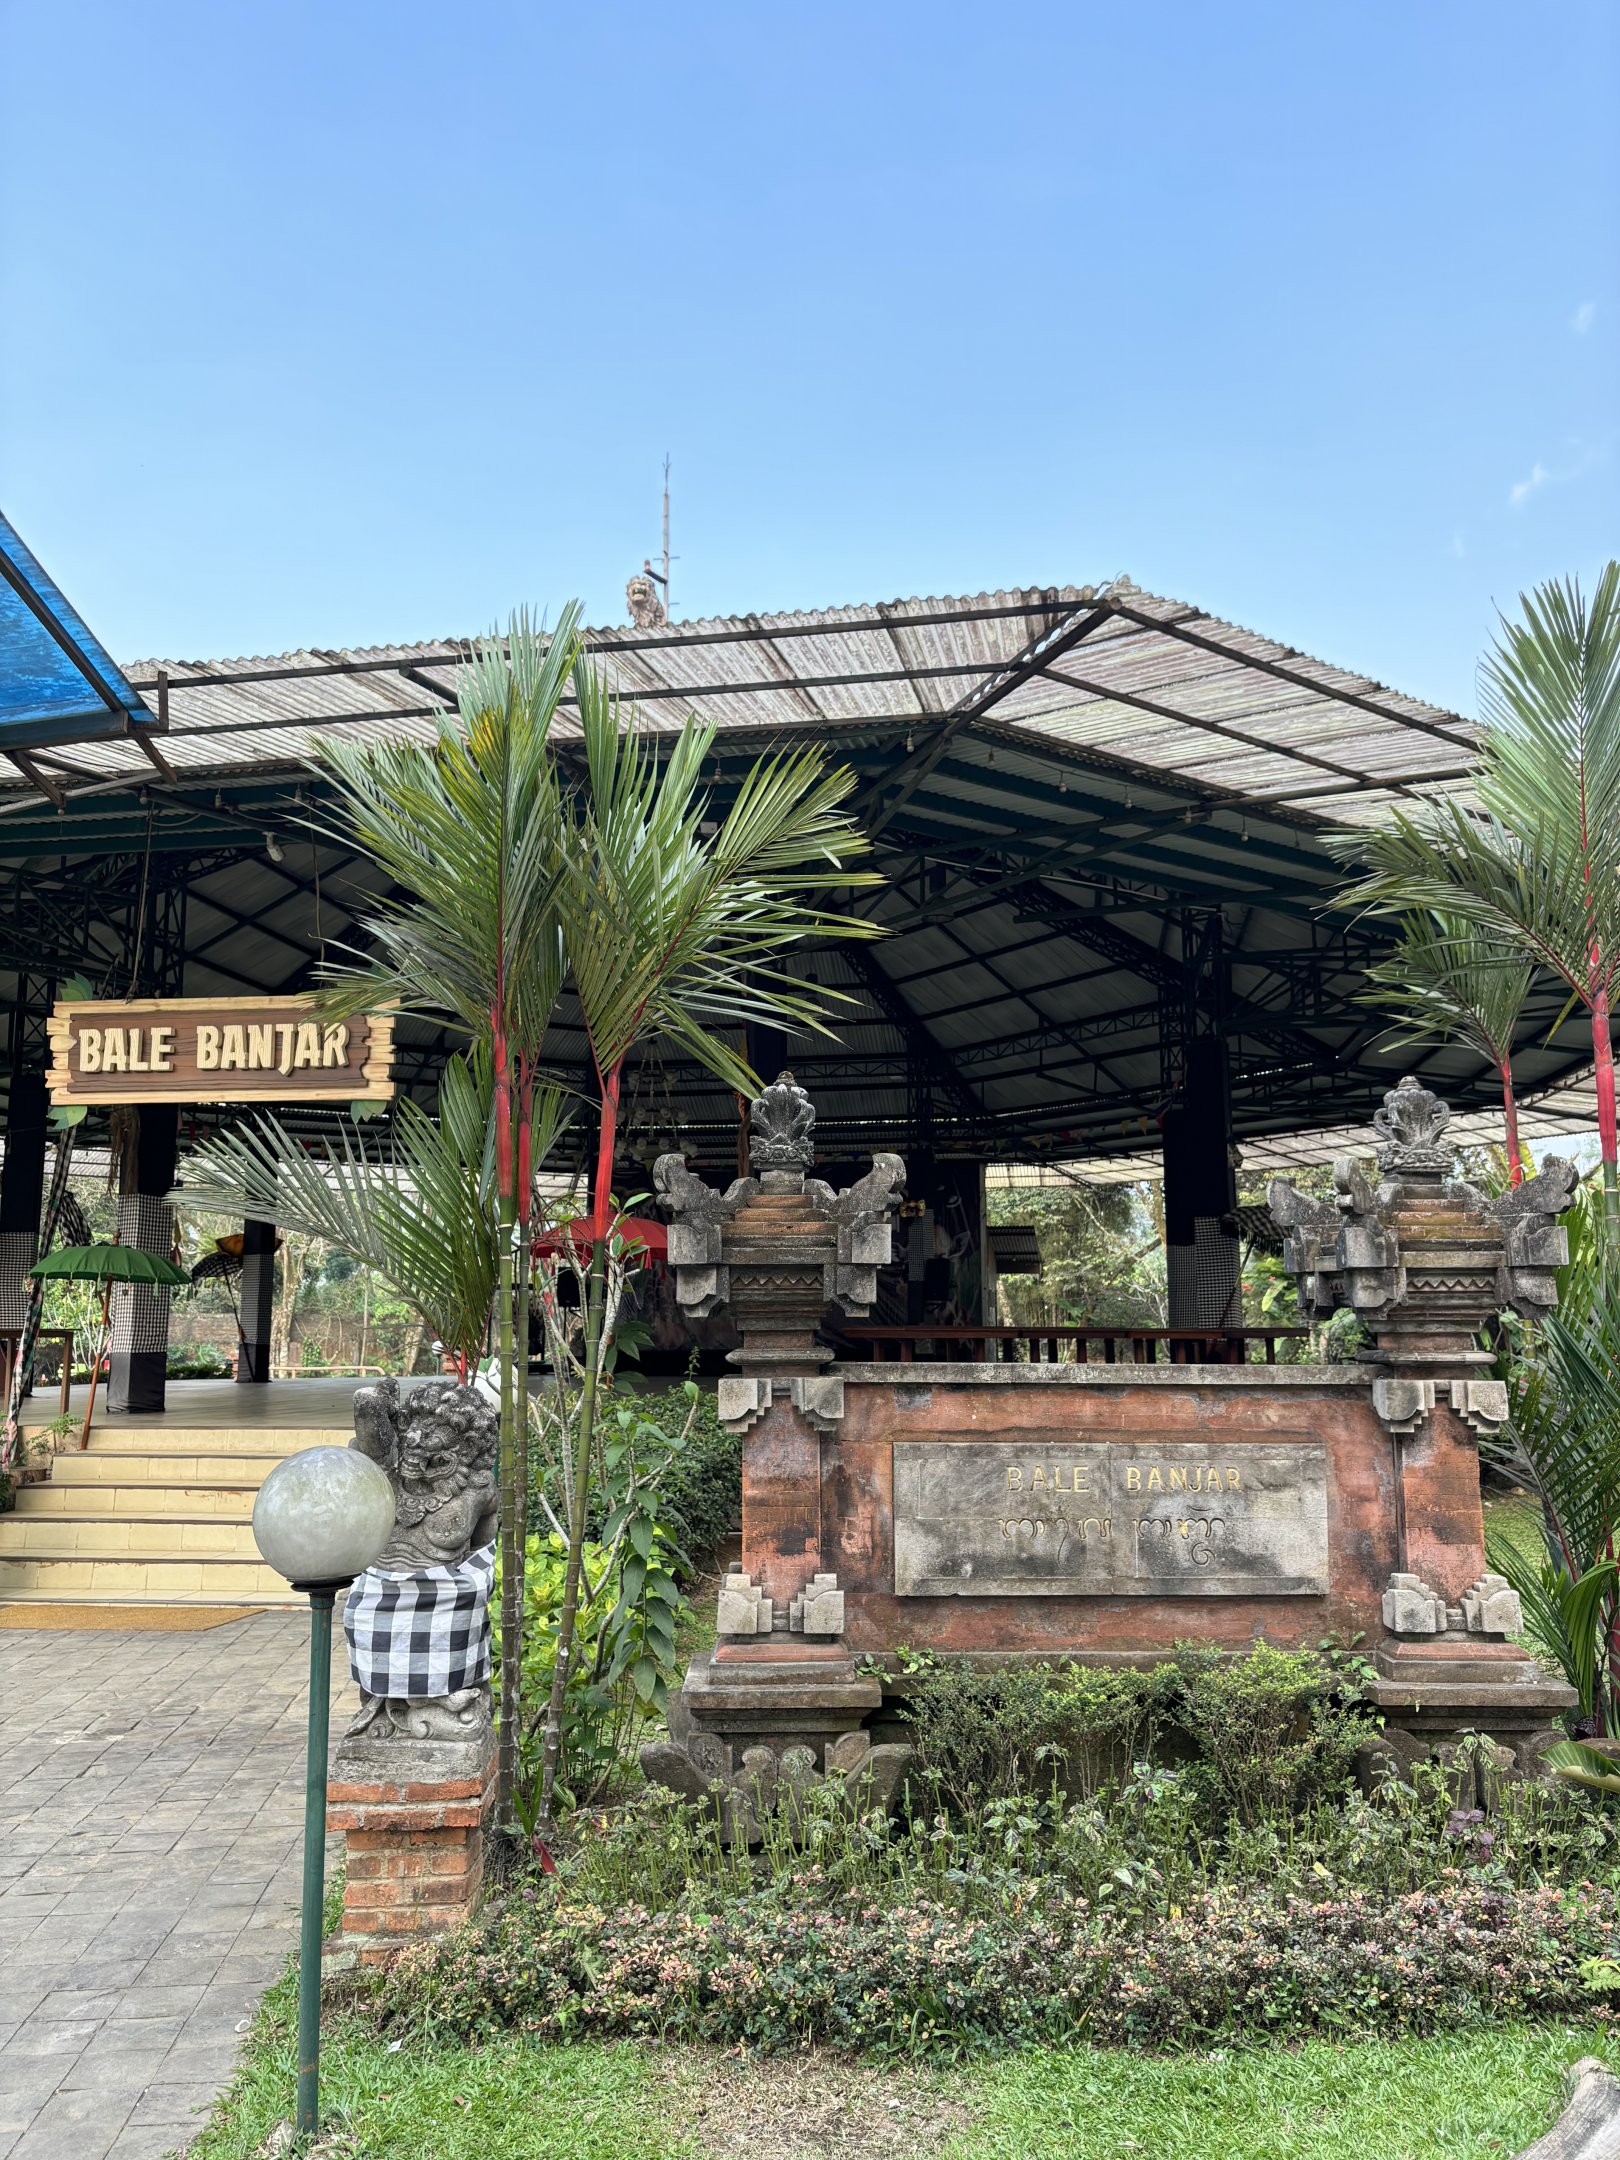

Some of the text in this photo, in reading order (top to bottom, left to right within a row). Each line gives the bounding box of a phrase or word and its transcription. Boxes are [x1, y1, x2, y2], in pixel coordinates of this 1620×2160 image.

[79, 1022, 350, 1077] BALE BANJAR
[1005, 1465, 1242, 1493] BALE BANJAR
